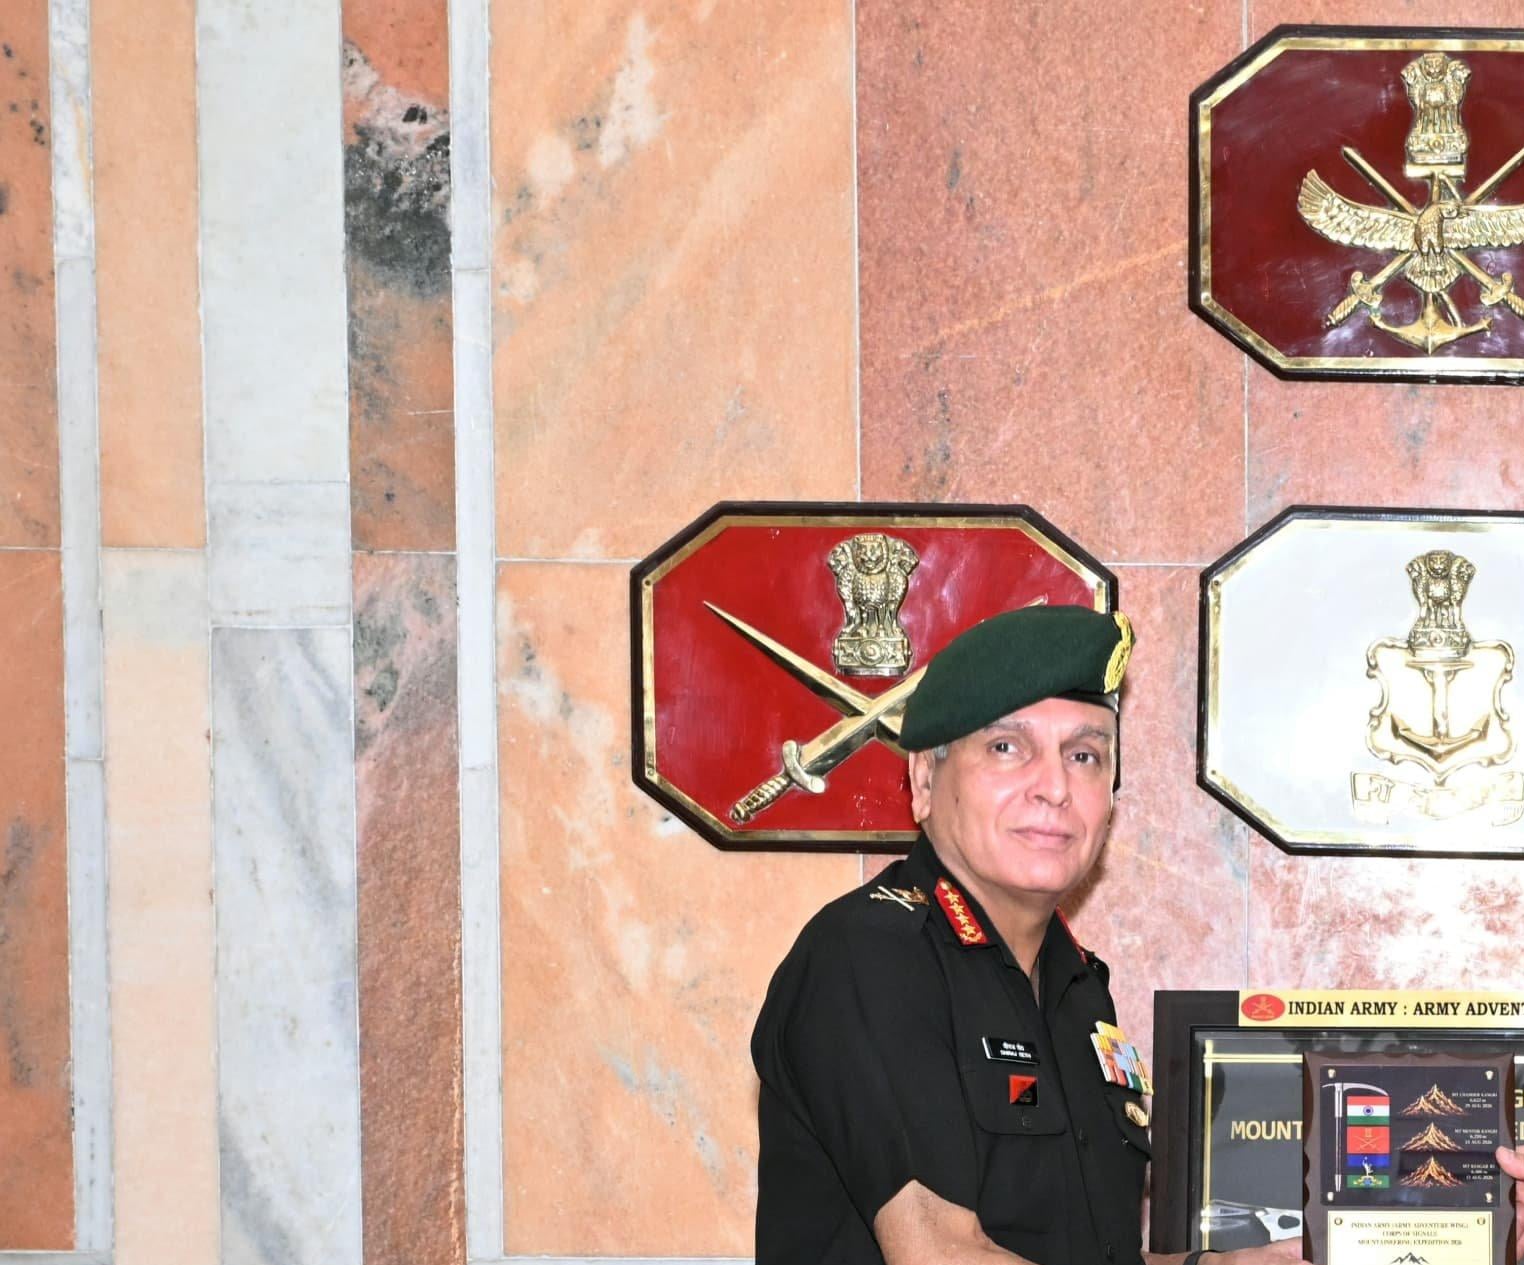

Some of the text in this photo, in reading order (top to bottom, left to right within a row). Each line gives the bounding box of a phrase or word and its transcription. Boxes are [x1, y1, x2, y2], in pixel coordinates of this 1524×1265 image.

[1288, 1001, 1345, 1015] INDIAN
[1350, 1001, 1398, 1016] ARMY
[1413, 1002, 1460, 1016] ARMY
